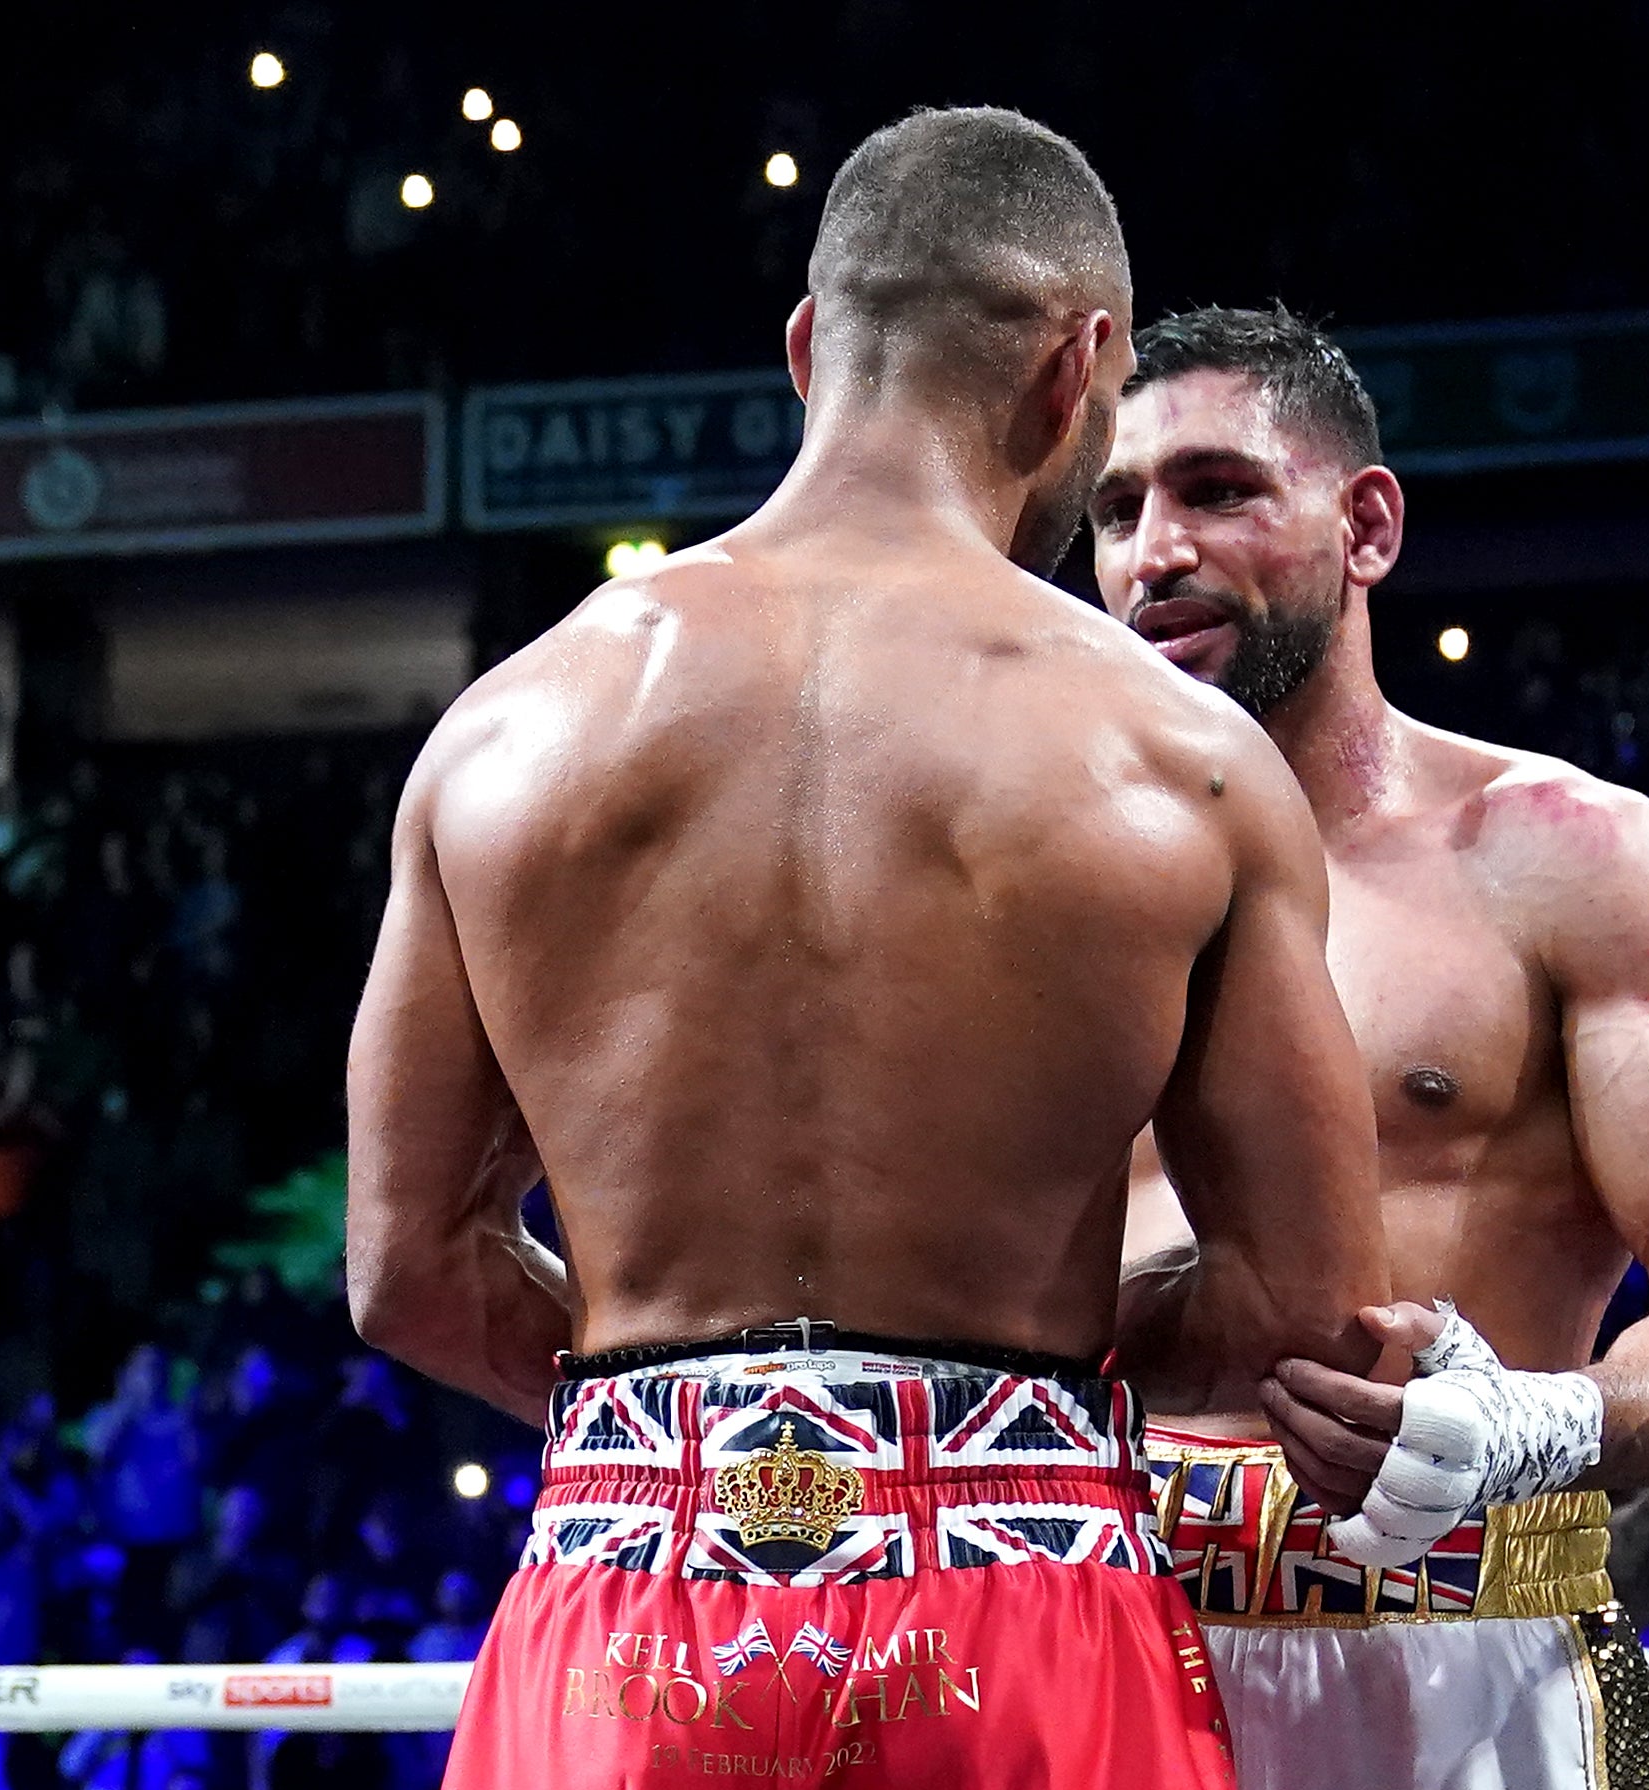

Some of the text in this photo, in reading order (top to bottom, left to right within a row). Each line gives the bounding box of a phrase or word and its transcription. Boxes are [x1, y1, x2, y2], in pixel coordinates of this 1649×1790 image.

[489, 406, 705, 472] DAISY
[604, 1631, 693, 1674] KELL
[562, 1667, 754, 1730] BROOK
[823, 1742, 878, 1776] 2022
